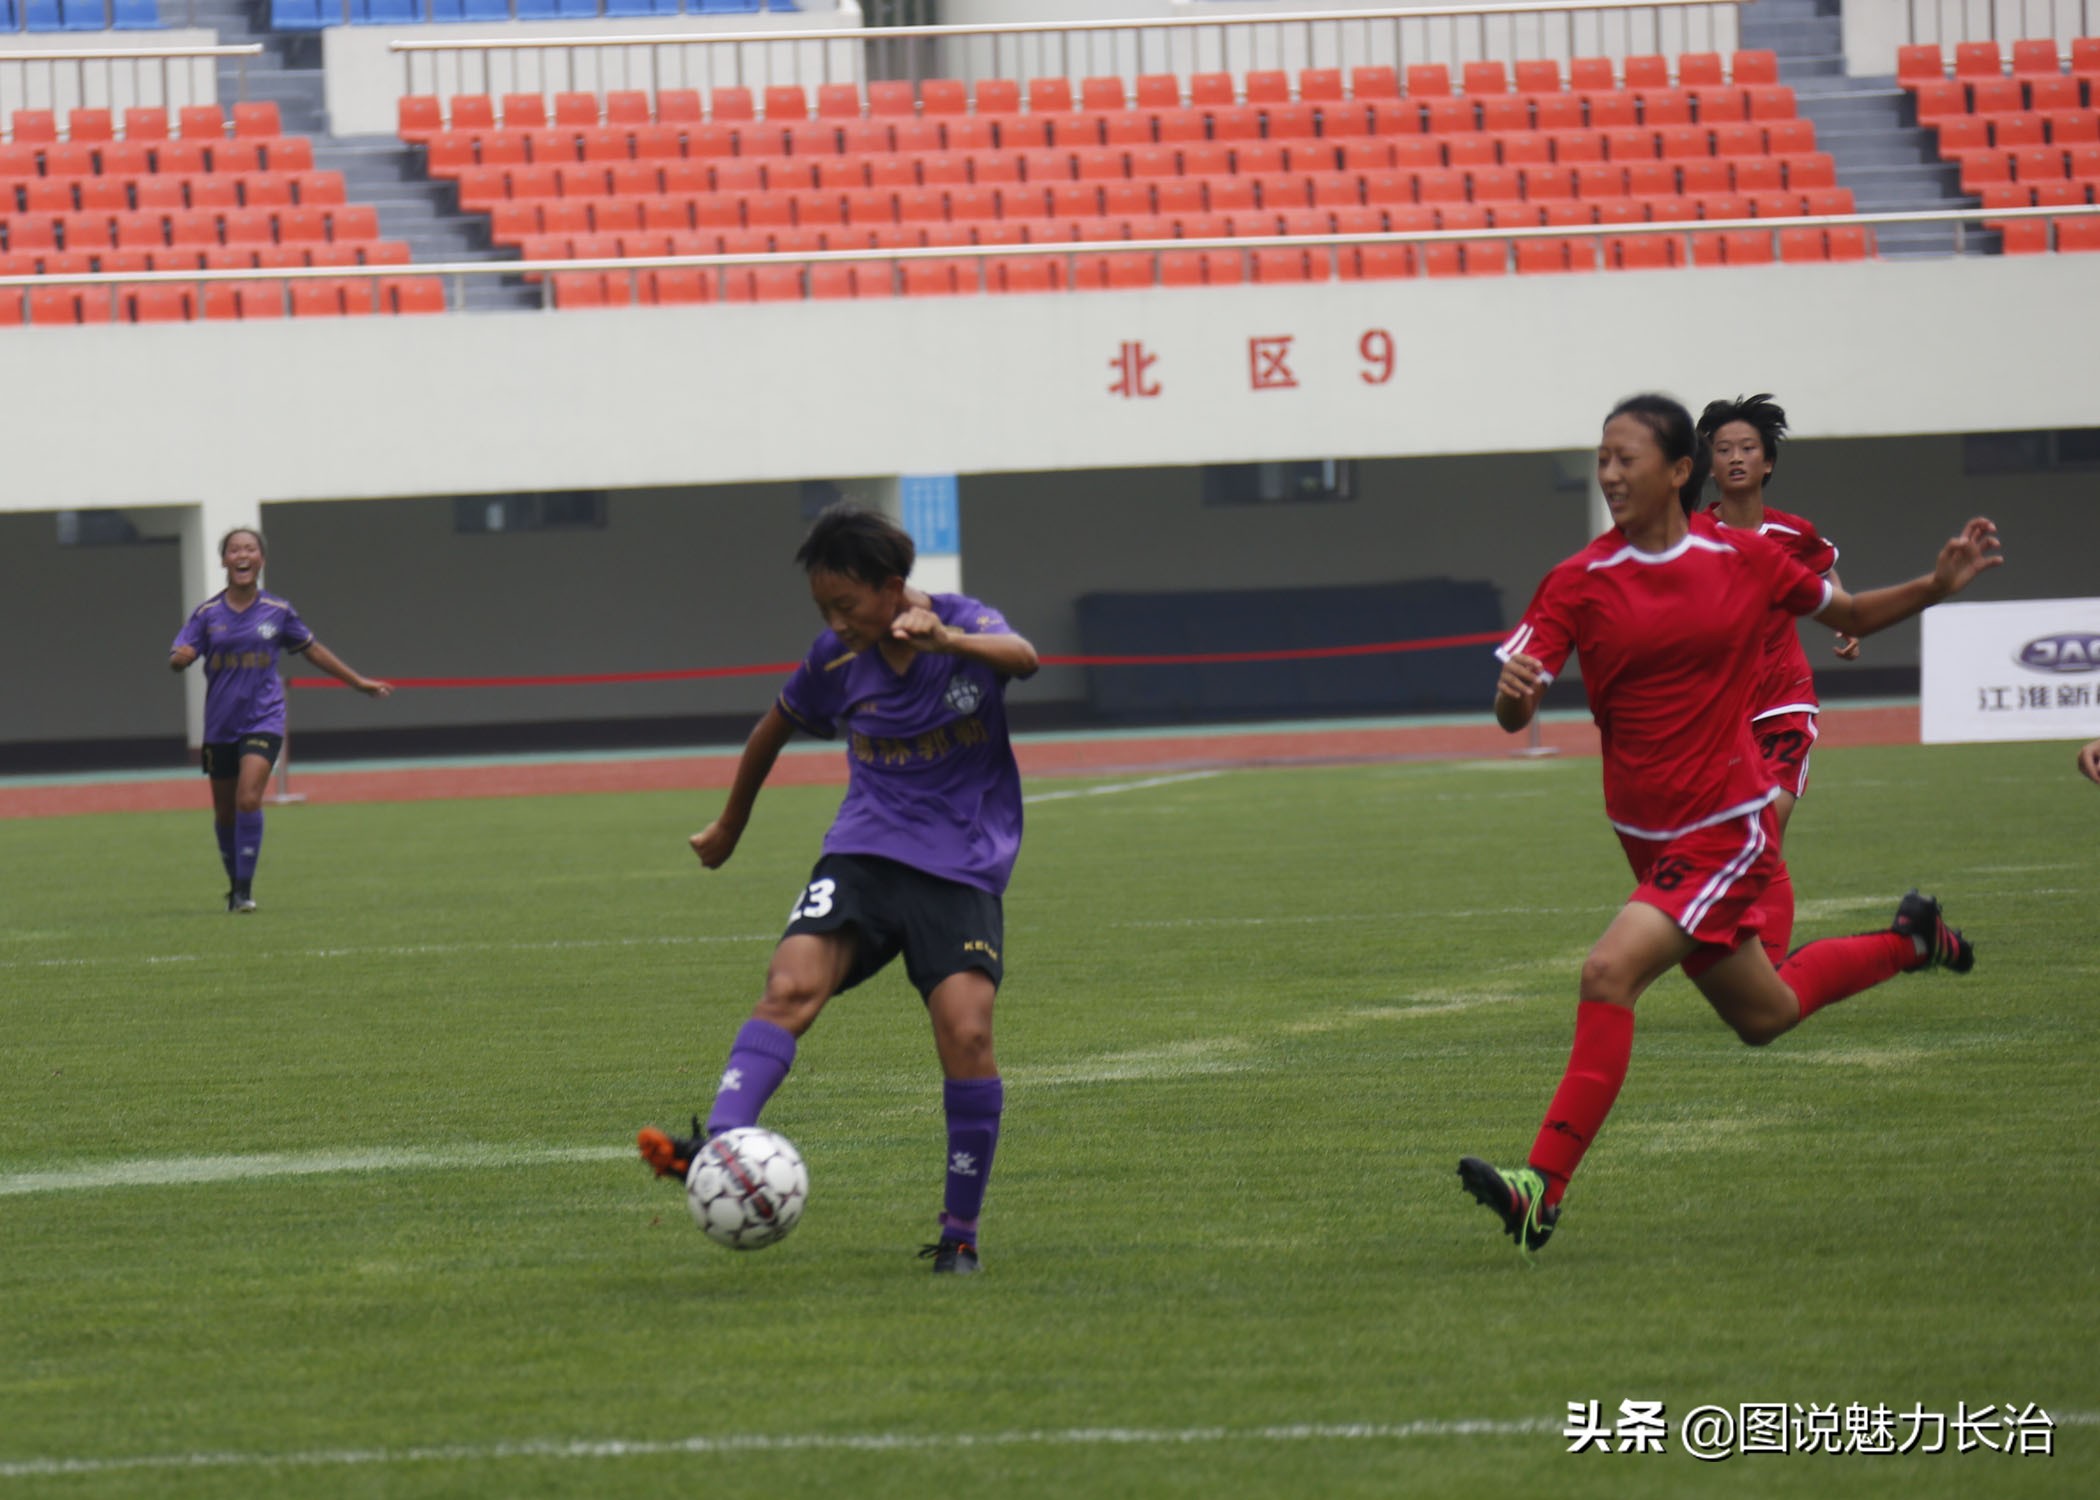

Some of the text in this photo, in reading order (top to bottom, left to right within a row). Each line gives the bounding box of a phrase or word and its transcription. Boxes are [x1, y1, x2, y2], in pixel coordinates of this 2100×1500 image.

[1358, 328, 1396, 385] 9
[1978, 683, 2100, 711] 江淮新
